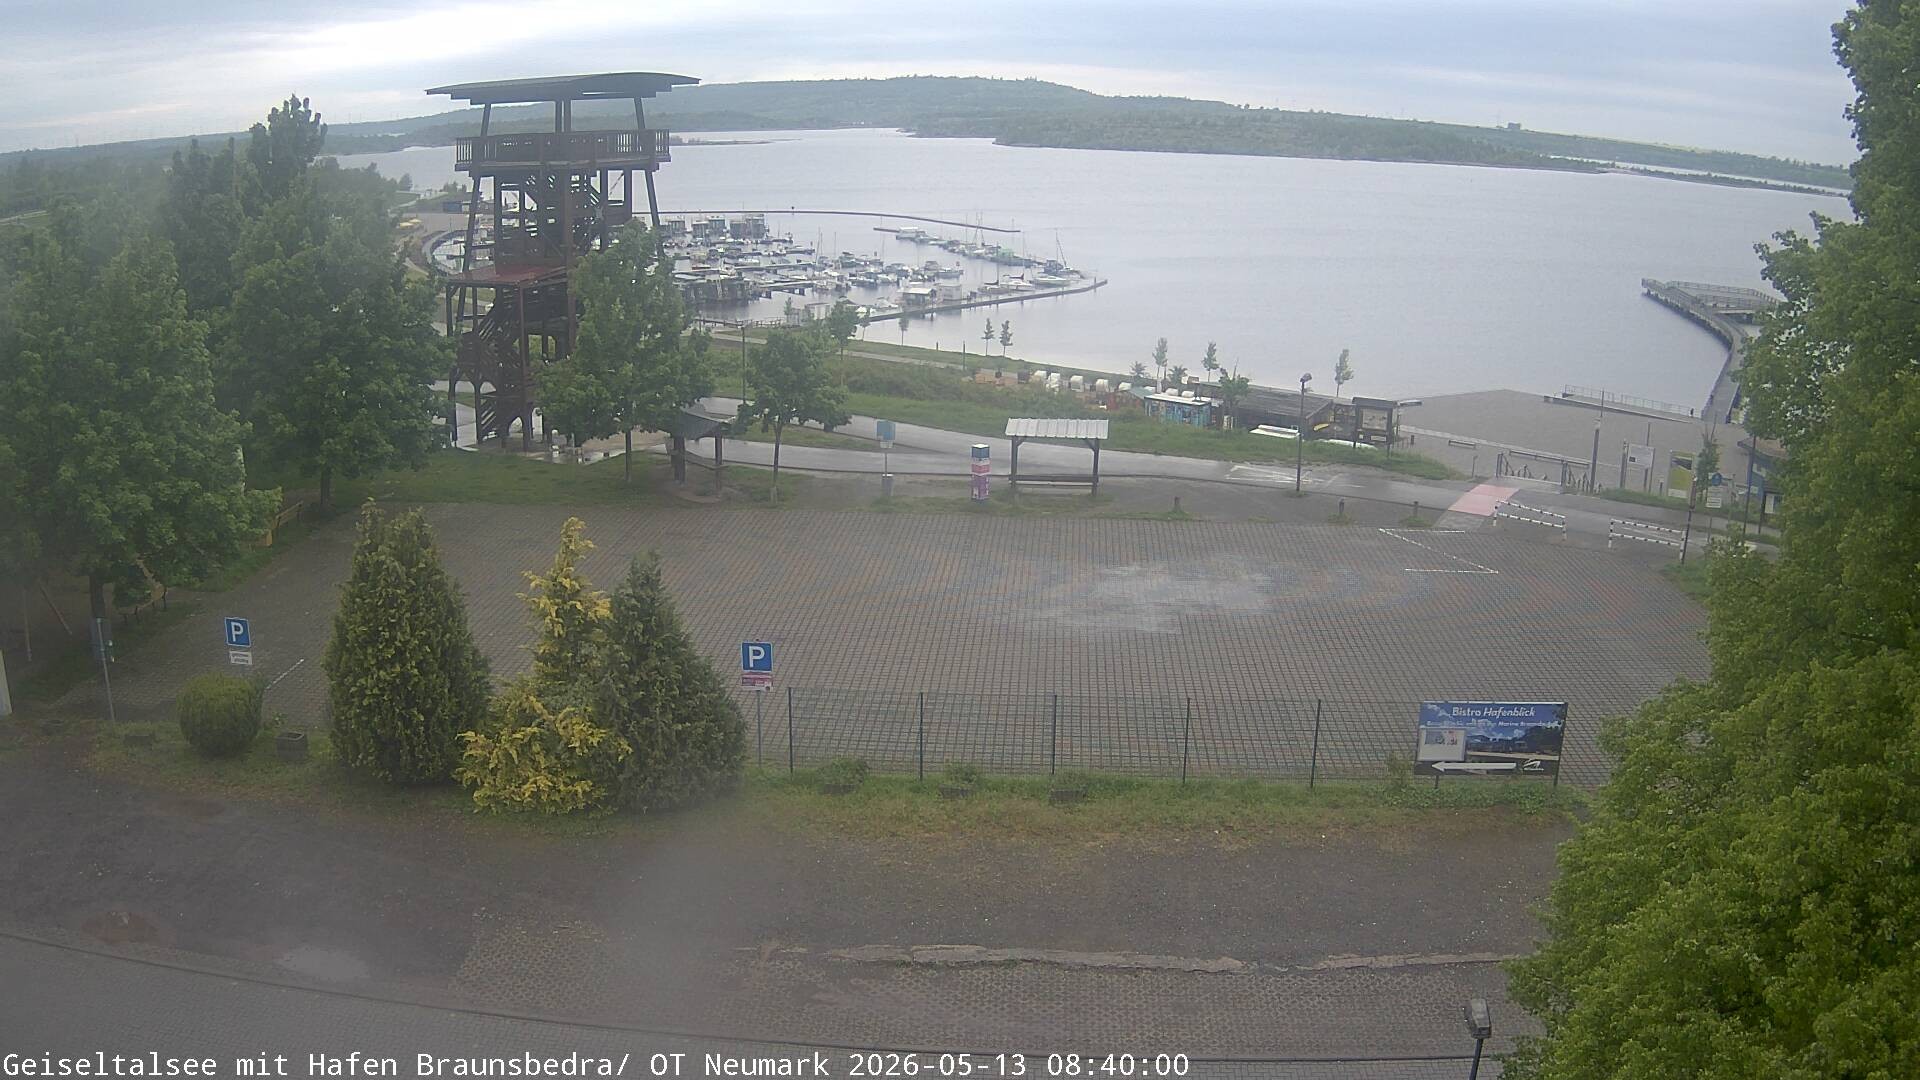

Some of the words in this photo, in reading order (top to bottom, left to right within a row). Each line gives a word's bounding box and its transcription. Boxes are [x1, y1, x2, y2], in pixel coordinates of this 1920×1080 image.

[231, 621, 244, 642] P
[749, 646, 765, 668] P
[1452, 707, 1481, 716] Bistro
[1483, 706, 1536, 719] Hafenblick
